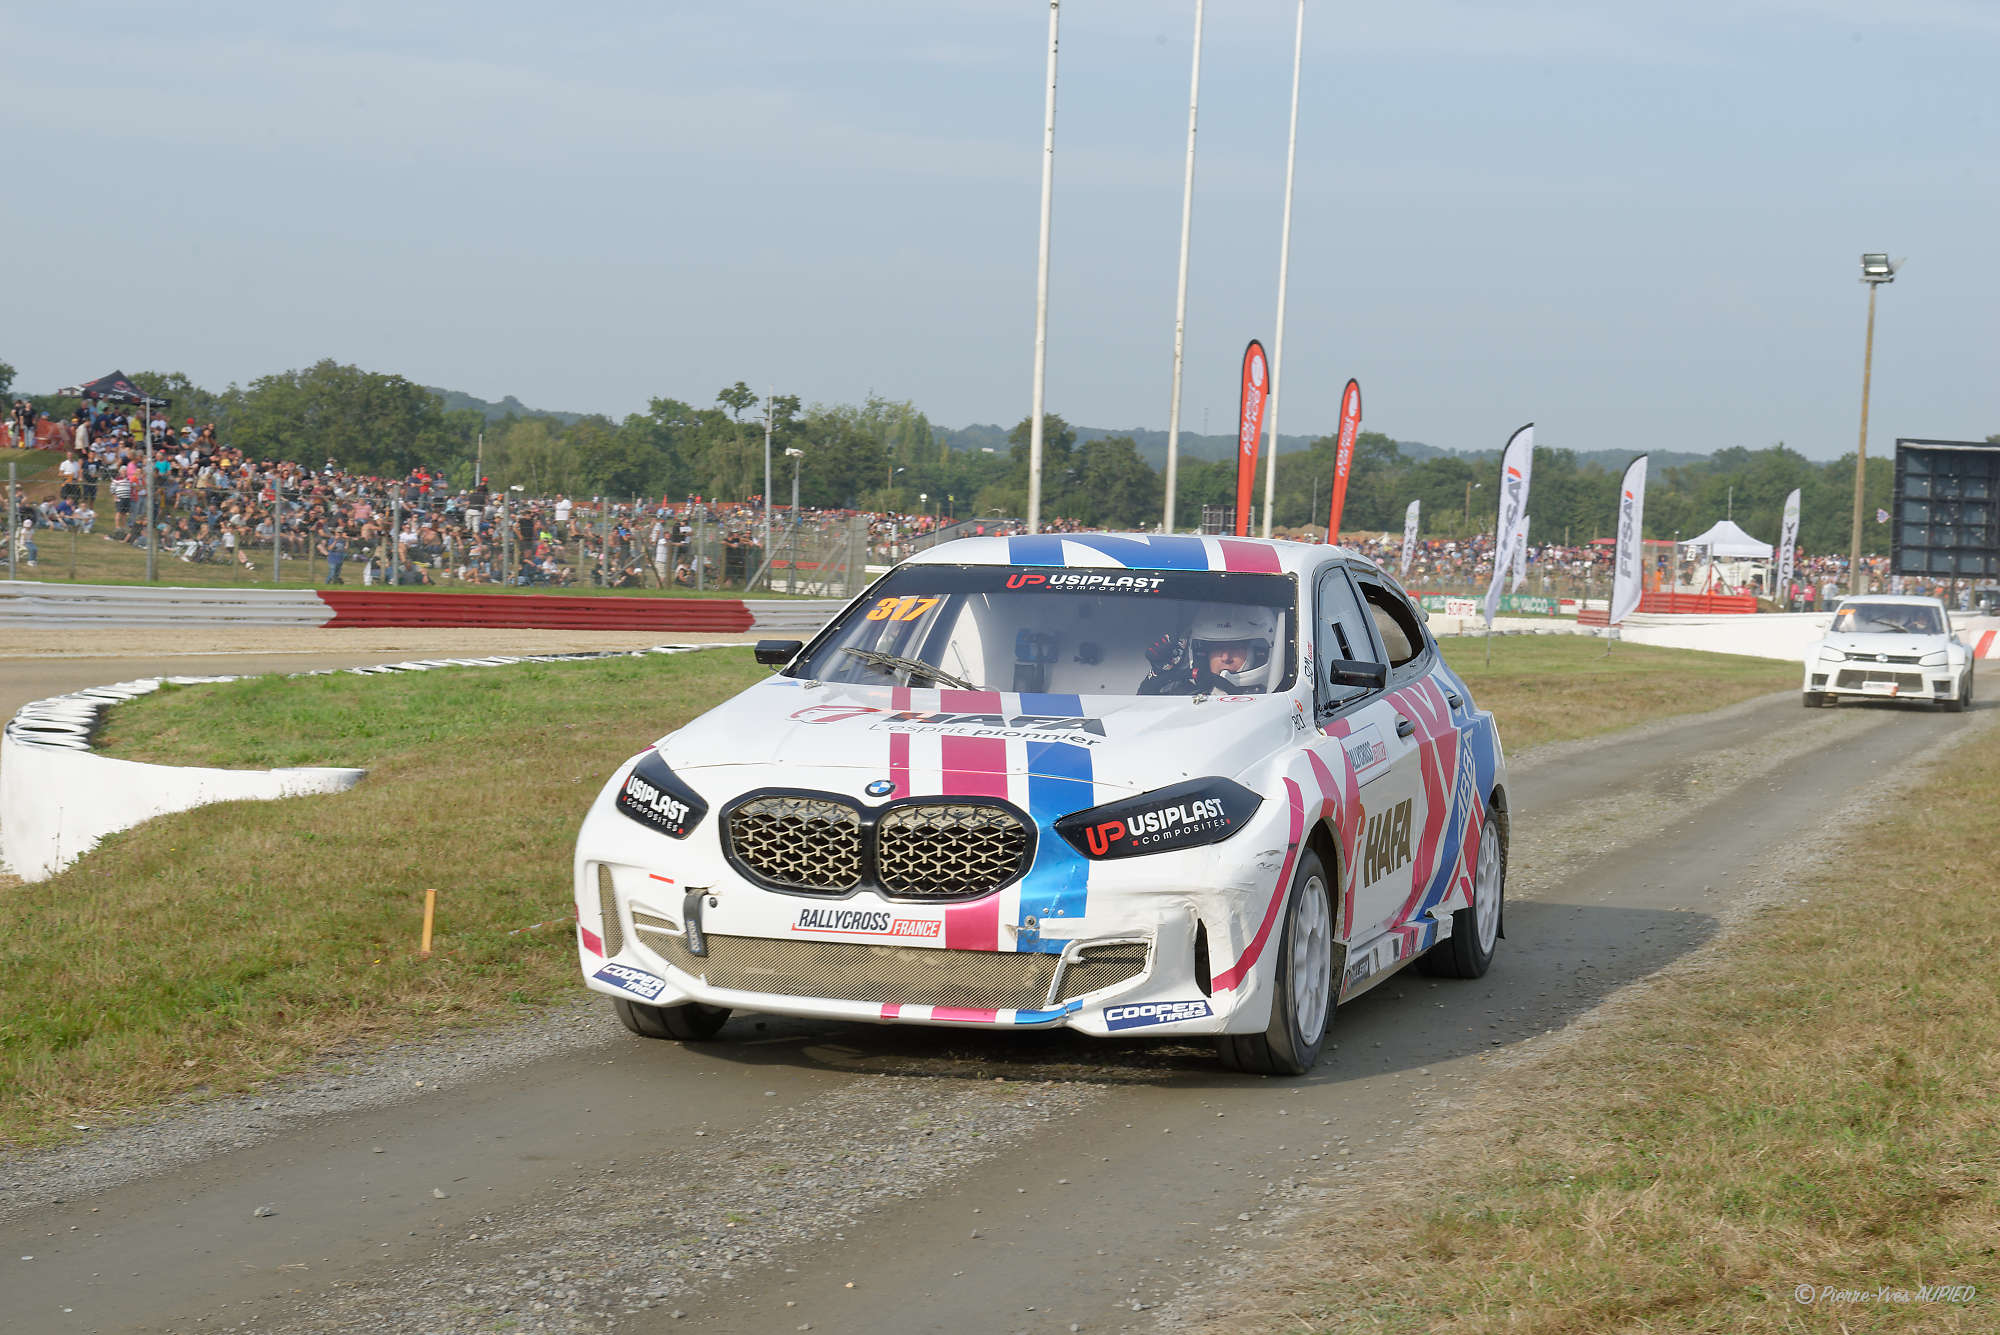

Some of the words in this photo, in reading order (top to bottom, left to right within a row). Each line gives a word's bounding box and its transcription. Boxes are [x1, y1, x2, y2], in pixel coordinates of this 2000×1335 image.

[1620, 501, 1633, 578] FFSA
[1049, 575, 1164, 588] USIPLAST
[1056, 585, 1150, 593] COMPOSITES
[866, 598, 939, 621] 317
[868, 722, 966, 735] L'esprit
[974, 728, 1102, 746] pionnier
[882, 712, 1107, 738] HAFA
[626, 775, 690, 824] USIPLAST
[627, 797, 678, 832] COMPOSITES
[1085, 820, 1126, 856] UP
[1127, 799, 1225, 836] USIPLAST
[1142, 818, 1225, 845] COMPOSITES
[1364, 798, 1412, 888] HAFA
[798, 908, 890, 931] RALLYCROSS
[893, 920, 938, 937] FRANCE
[601, 964, 667, 991] COOPER
[622, 981, 656, 997] TIRES
[1106, 1001, 1206, 1021] COOPER
[1155, 1010, 1207, 1022] TIRES
